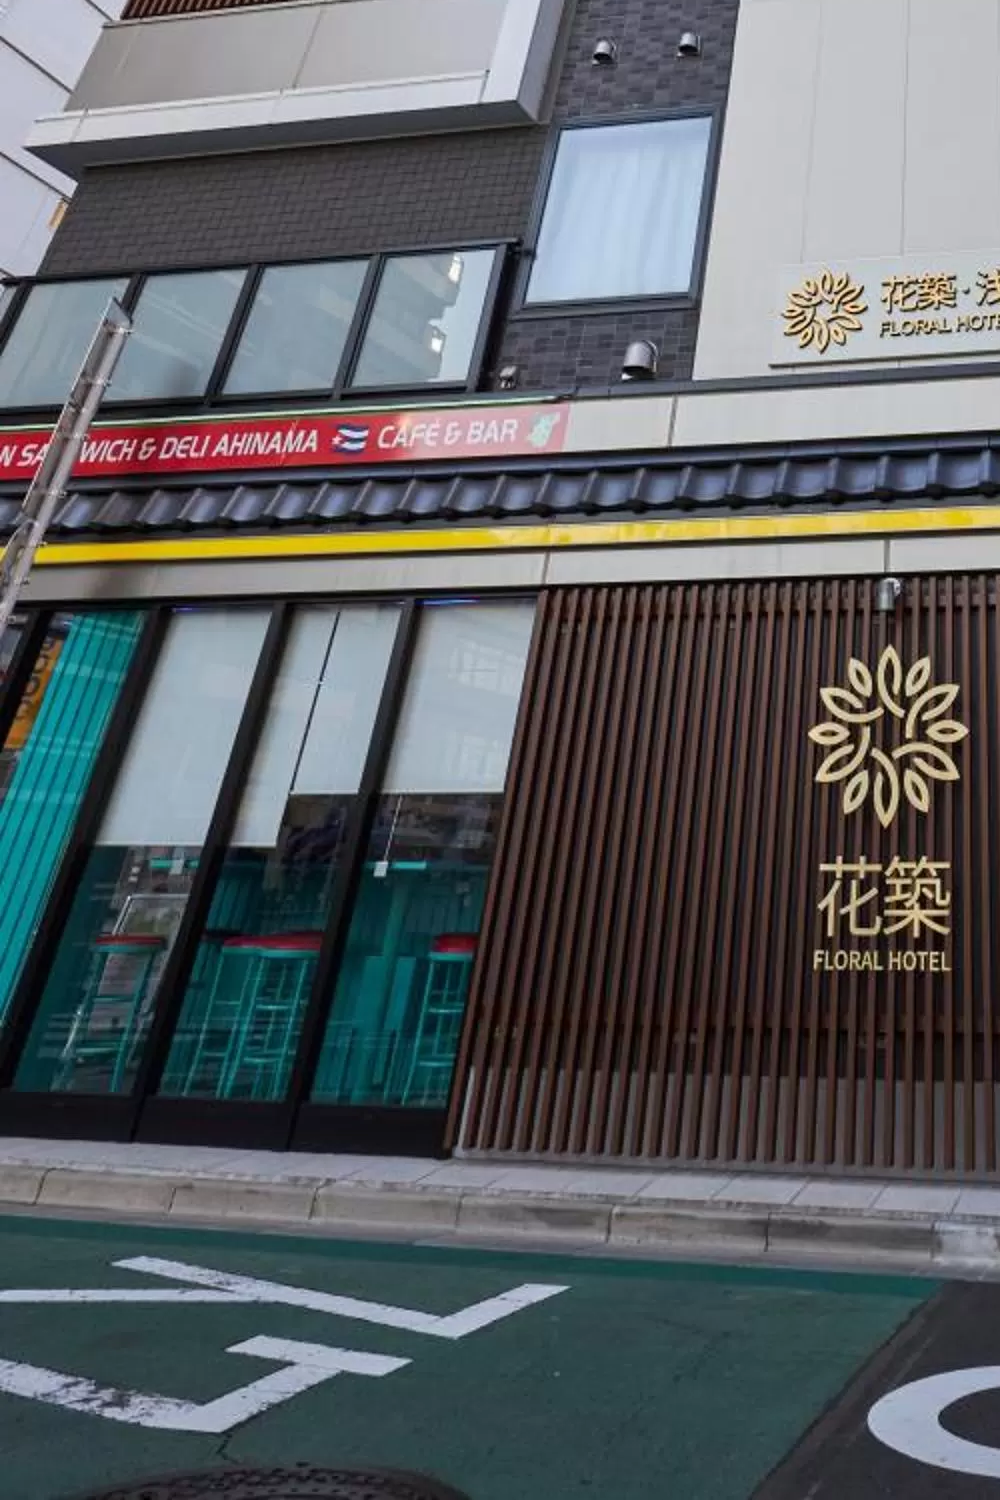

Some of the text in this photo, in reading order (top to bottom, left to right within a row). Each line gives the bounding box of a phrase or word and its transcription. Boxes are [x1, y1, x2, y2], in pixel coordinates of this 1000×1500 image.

[880, 317, 952, 337] FLORAL
[16, 440, 137, 467] SAWICH
[138, 437, 157, 461] &
[158, 435, 209, 460] DELI
[211, 429, 318, 457] AHINAMA
[444, 422, 463, 444] &
[467, 418, 518, 444] BAR
[817, 855, 951, 938] 花築
[813, 949, 952, 971] FLORAL HOTEL
